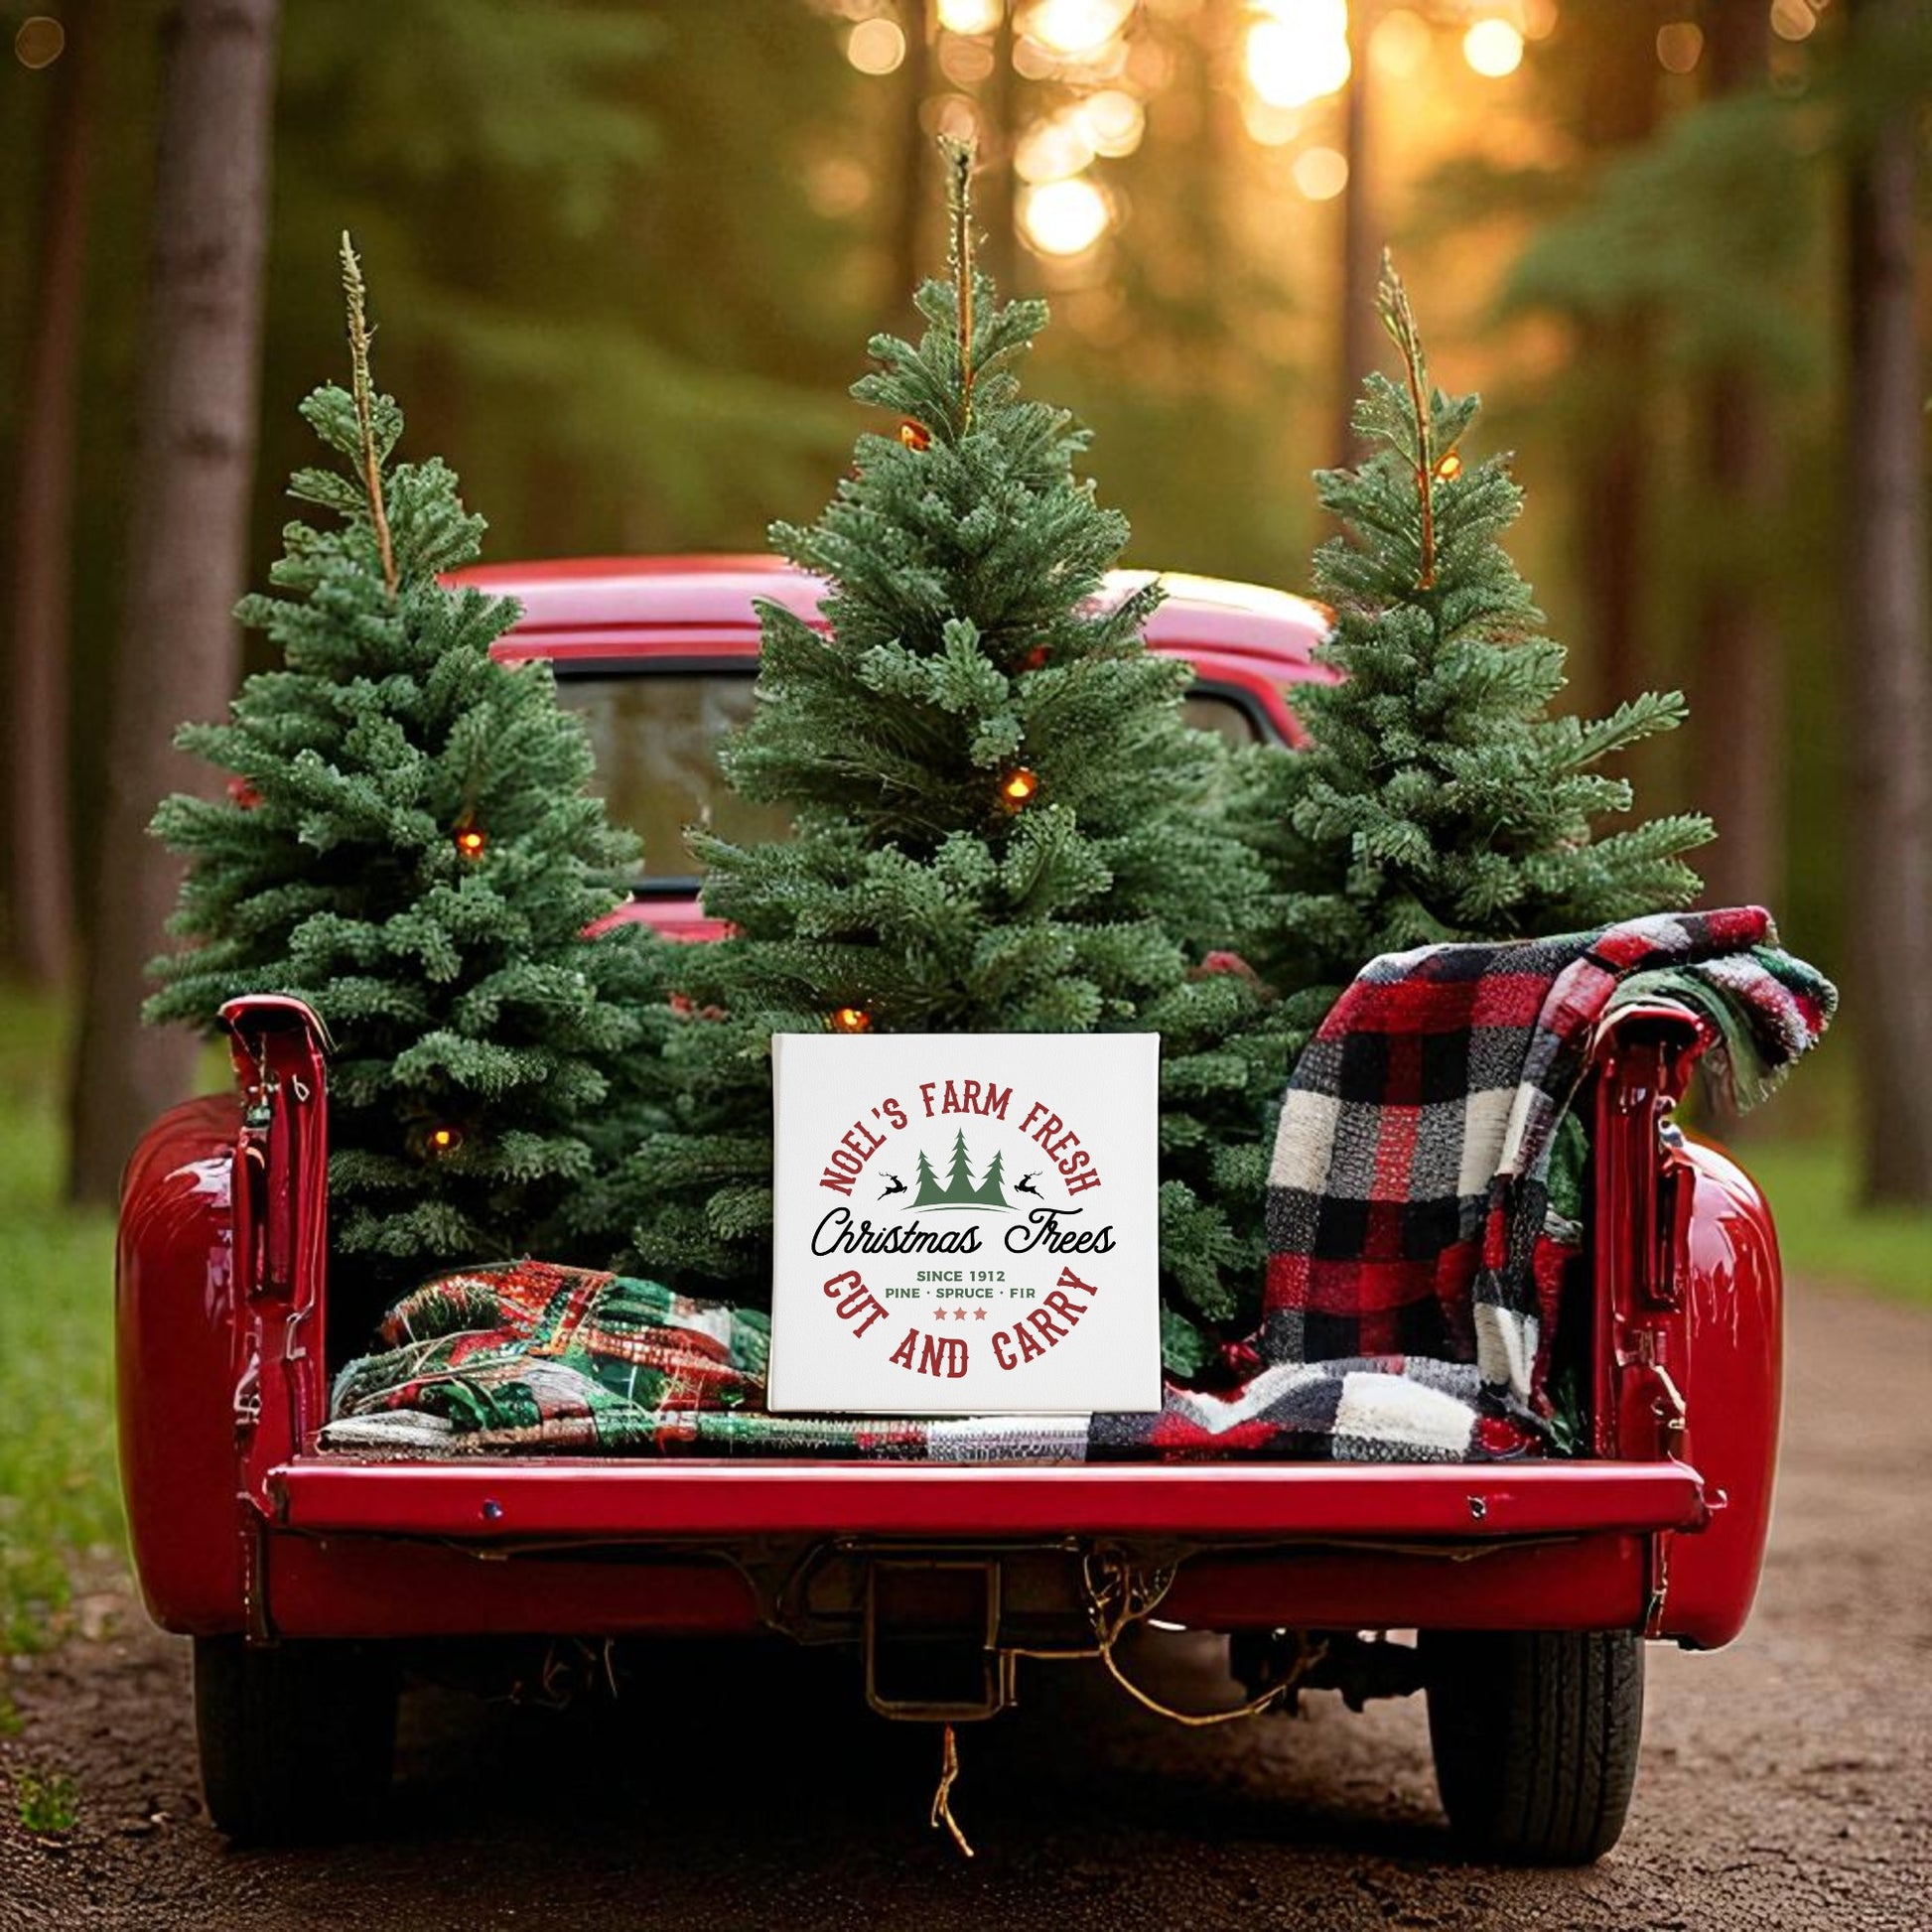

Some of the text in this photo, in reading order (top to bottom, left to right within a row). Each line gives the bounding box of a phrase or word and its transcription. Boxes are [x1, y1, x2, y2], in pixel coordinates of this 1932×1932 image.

[819, 1079, 1101, 1196] NOEL'S FARM FRESH
[811, 1206, 1117, 1257] Christmas Trees
[885, 1288, 1035, 1300] PINE SPRUCE FIR
[915, 1270, 1006, 1283] SINCE 1912
[823, 1266, 1098, 1379] CUT AND CARRY
